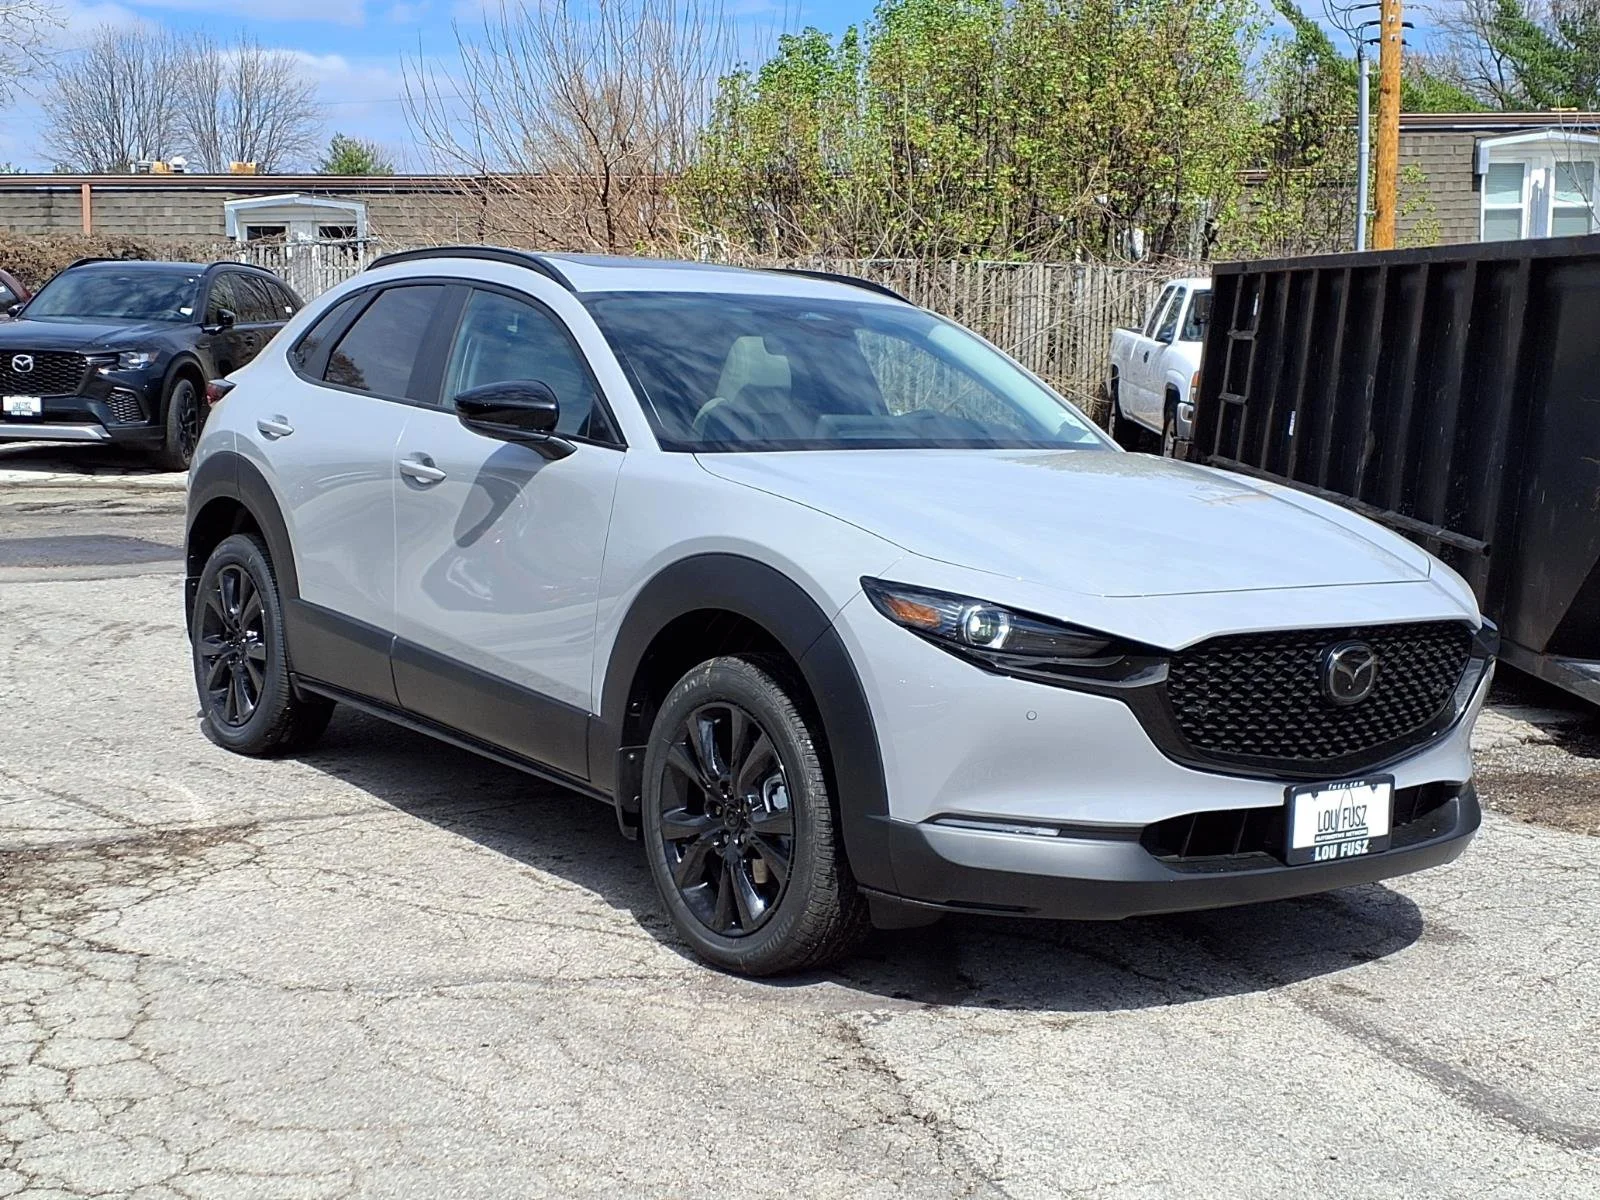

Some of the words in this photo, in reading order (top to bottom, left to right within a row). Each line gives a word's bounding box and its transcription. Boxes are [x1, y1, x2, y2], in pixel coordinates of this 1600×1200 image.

[1317, 808, 1339, 833] LOU
[1342, 805, 1367, 829] FUSZ
[1314, 844, 1338, 861] LOU
[1340, 839, 1369, 858] FUSZ
